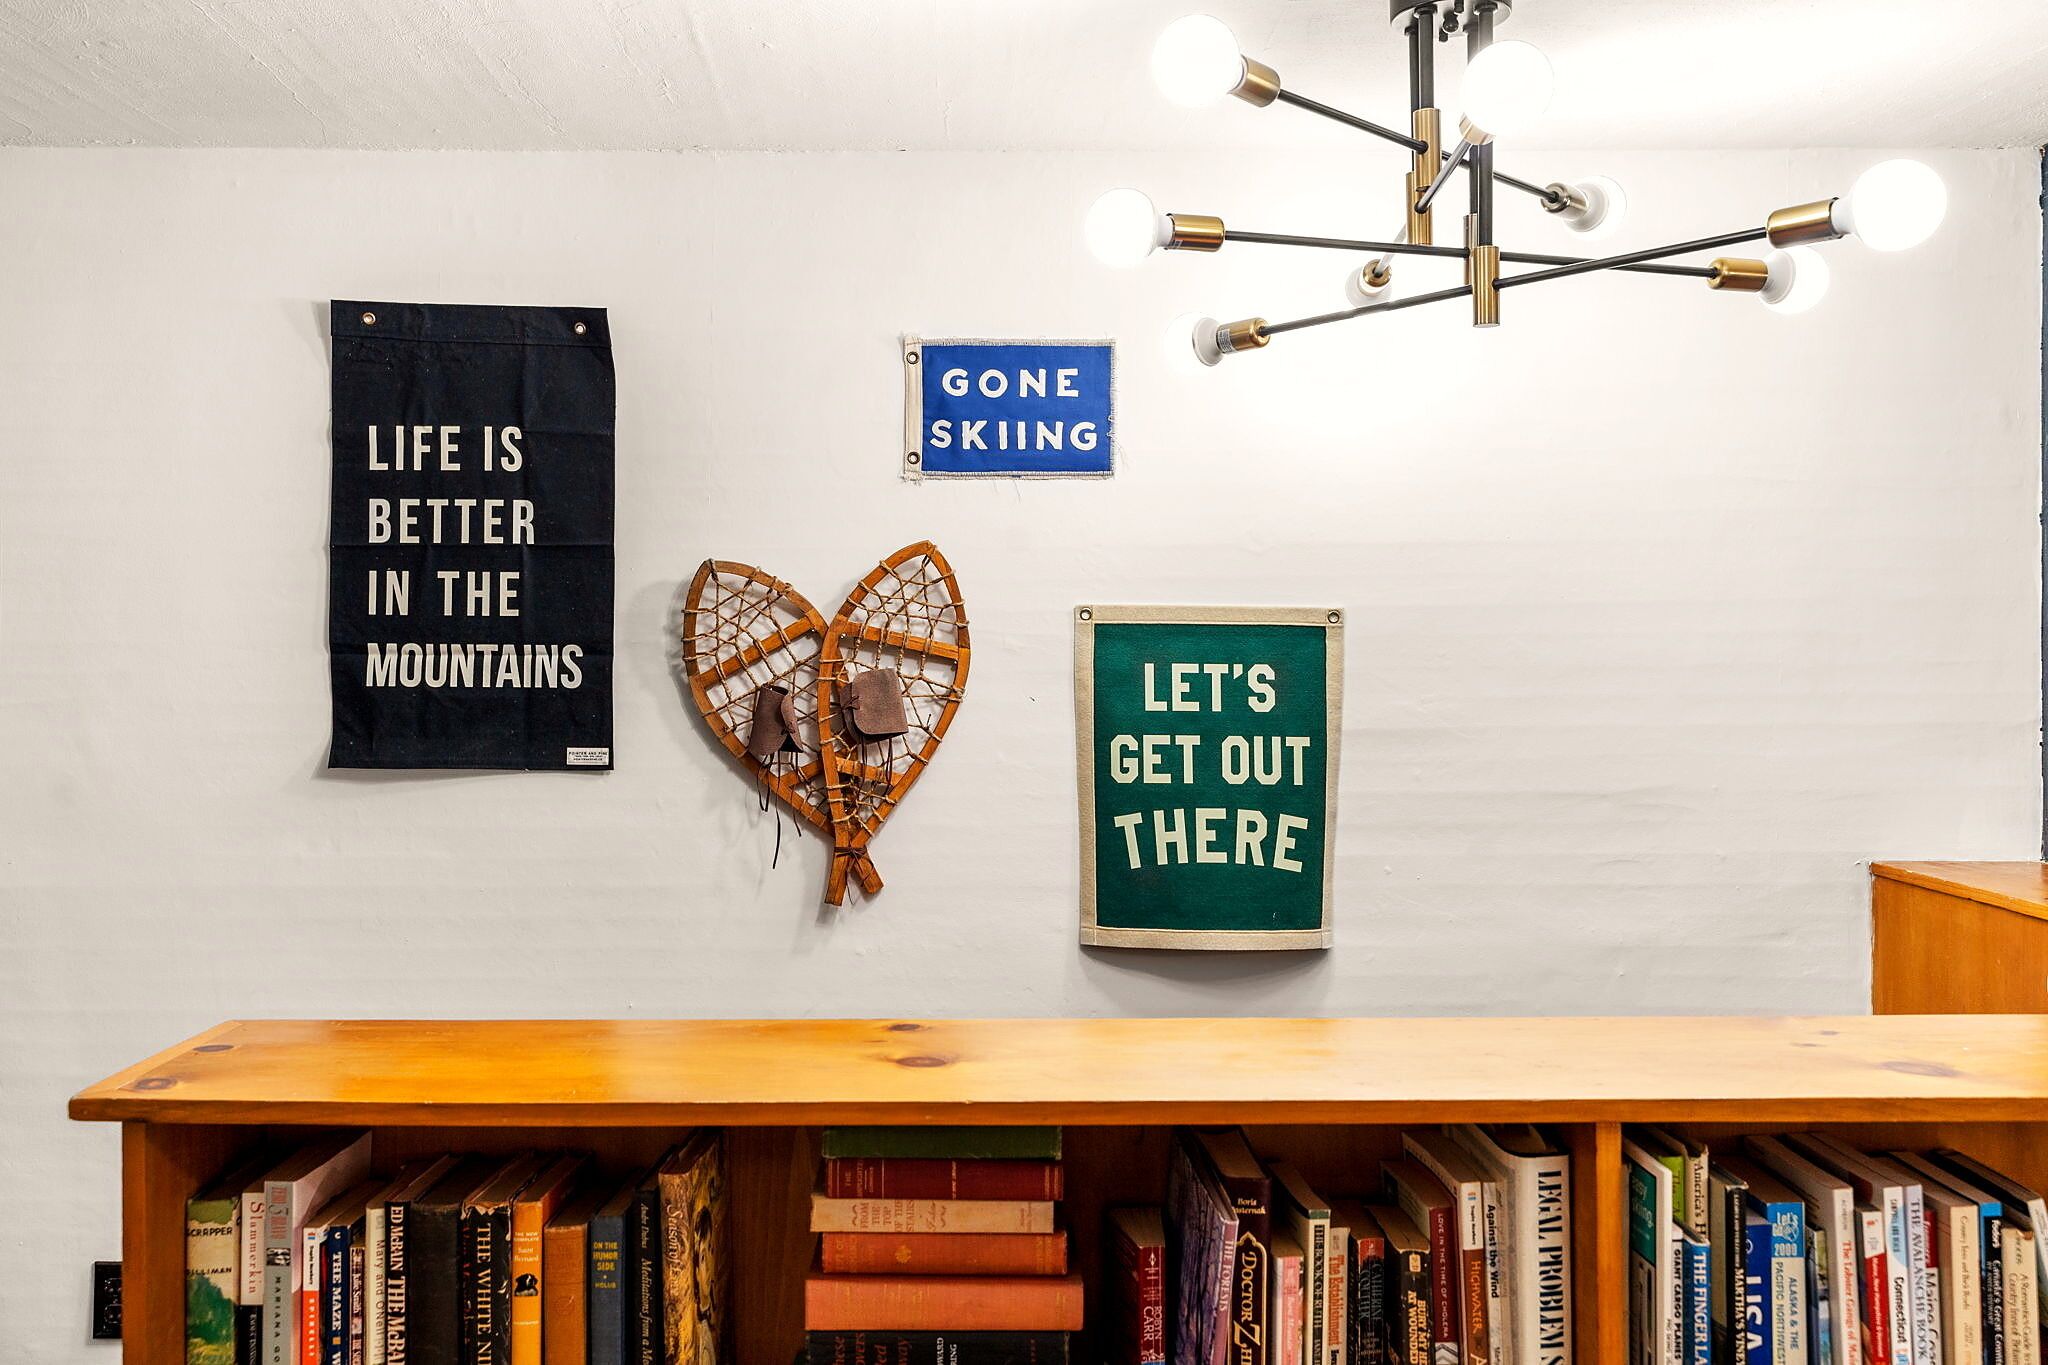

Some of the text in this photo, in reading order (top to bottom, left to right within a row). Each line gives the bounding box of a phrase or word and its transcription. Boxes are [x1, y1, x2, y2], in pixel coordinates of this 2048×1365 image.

[942, 368, 1079, 398] GONE
[368, 425, 523, 472] LIFE IS
[930, 419, 1097, 451] SKIING
[368, 498, 535, 545] BETTER
[368, 570, 519, 616] IN THE
[365, 642, 583, 689] MOUNTAINS
[1144, 663, 1275, 713] LET'S
[1110, 734, 1311, 785] GET OUT
[1114, 807, 1309, 873] THERE
[1694, 1163, 1706, 1218] America's
[666, 1204, 683, 1250] Season
[860, 1202, 869, 1229] FROM
[872, 1206, 880, 1225] THE
[883, 1206, 891, 1225] TOP
[249, 1201, 265, 1294] Slammerkin
[374, 1239, 385, 1268] Mary
[391, 1206, 404, 1271] ED McBAIN
[477, 1223, 491, 1263] THE
[593, 1242, 618, 1250] ON THE
[1314, 1226, 1324, 1245] THE
[1439, 1236, 1444, 1245] IN
[1486, 1204, 1500, 1298] Against the Wind
[1774, 1243, 1797, 1256] 2000
[1842, 1240, 1852, 1259] The
[332, 1251, 342, 1284] THE
[592, 1251, 618, 1260] HUMOR
[597, 1262, 615, 1270] SIDE
[1314, 1248, 1324, 1280] BOOK
[1331, 1254, 1345, 1274] The
[1538, 1170, 1564, 1349] LEGAL PROBLEM
[1674, 1249, 1682, 1280] GIANT
[1694, 1252, 1706, 1286] THE
[376, 1274, 385, 1298] and
[387, 1276, 405, 1312] THE
[640, 1258, 652, 1313] Meditations
[1219, 1240, 1235, 1312] THE FORESTS
[1241, 1251, 1257, 1322] DOCTOR
[1314, 1281, 1324, 1296] OF
[1371, 1263, 1382, 1321] CATHERINE
[1441, 1288, 1447, 1298] OF
[1775, 1262, 1784, 1301] PACIFIC
[1844, 1261, 1854, 1296] Lobster
[1910, 1199, 1927, 1360] THE AVALANCHE BOOK
[332, 1286, 342, 1331] MAZE
[477, 1268, 491, 1334] WHITE
[1329, 1277, 1344, 1345] Establishment
[1359, 1269, 1370, 1320] COULTER
[1470, 1260, 1483, 1334] HIGHWATER
[1674, 1284, 1682, 1319] CARGO
[1734, 1268, 1744, 1329] MARTHA'S
[1894, 1276, 1907, 1343] Connecticut
[1993, 1260, 2002, 1331] Canada's Great
[2007, 1272, 2021, 1336] Country Inns of
[638, 1312, 652, 1337] from
[1143, 1306, 1153, 1341] CARR
[1154, 1306, 1162, 1340] ROBYN
[1314, 1299, 1324, 1328] RUTH
[1408, 1290, 1419, 1364] AT WOUNDED
[1417, 1299, 1427, 1329] BURY
[1694, 1287, 1708, 1343] FINGER
[1788, 1276, 1799, 1350] ALASKA & THE
[641, 1338, 648, 1346] a
[1418, 1331, 1427, 1350] MY
[1848, 1331, 1856, 1341] of
[2023, 1326, 2032, 1349] Guide
